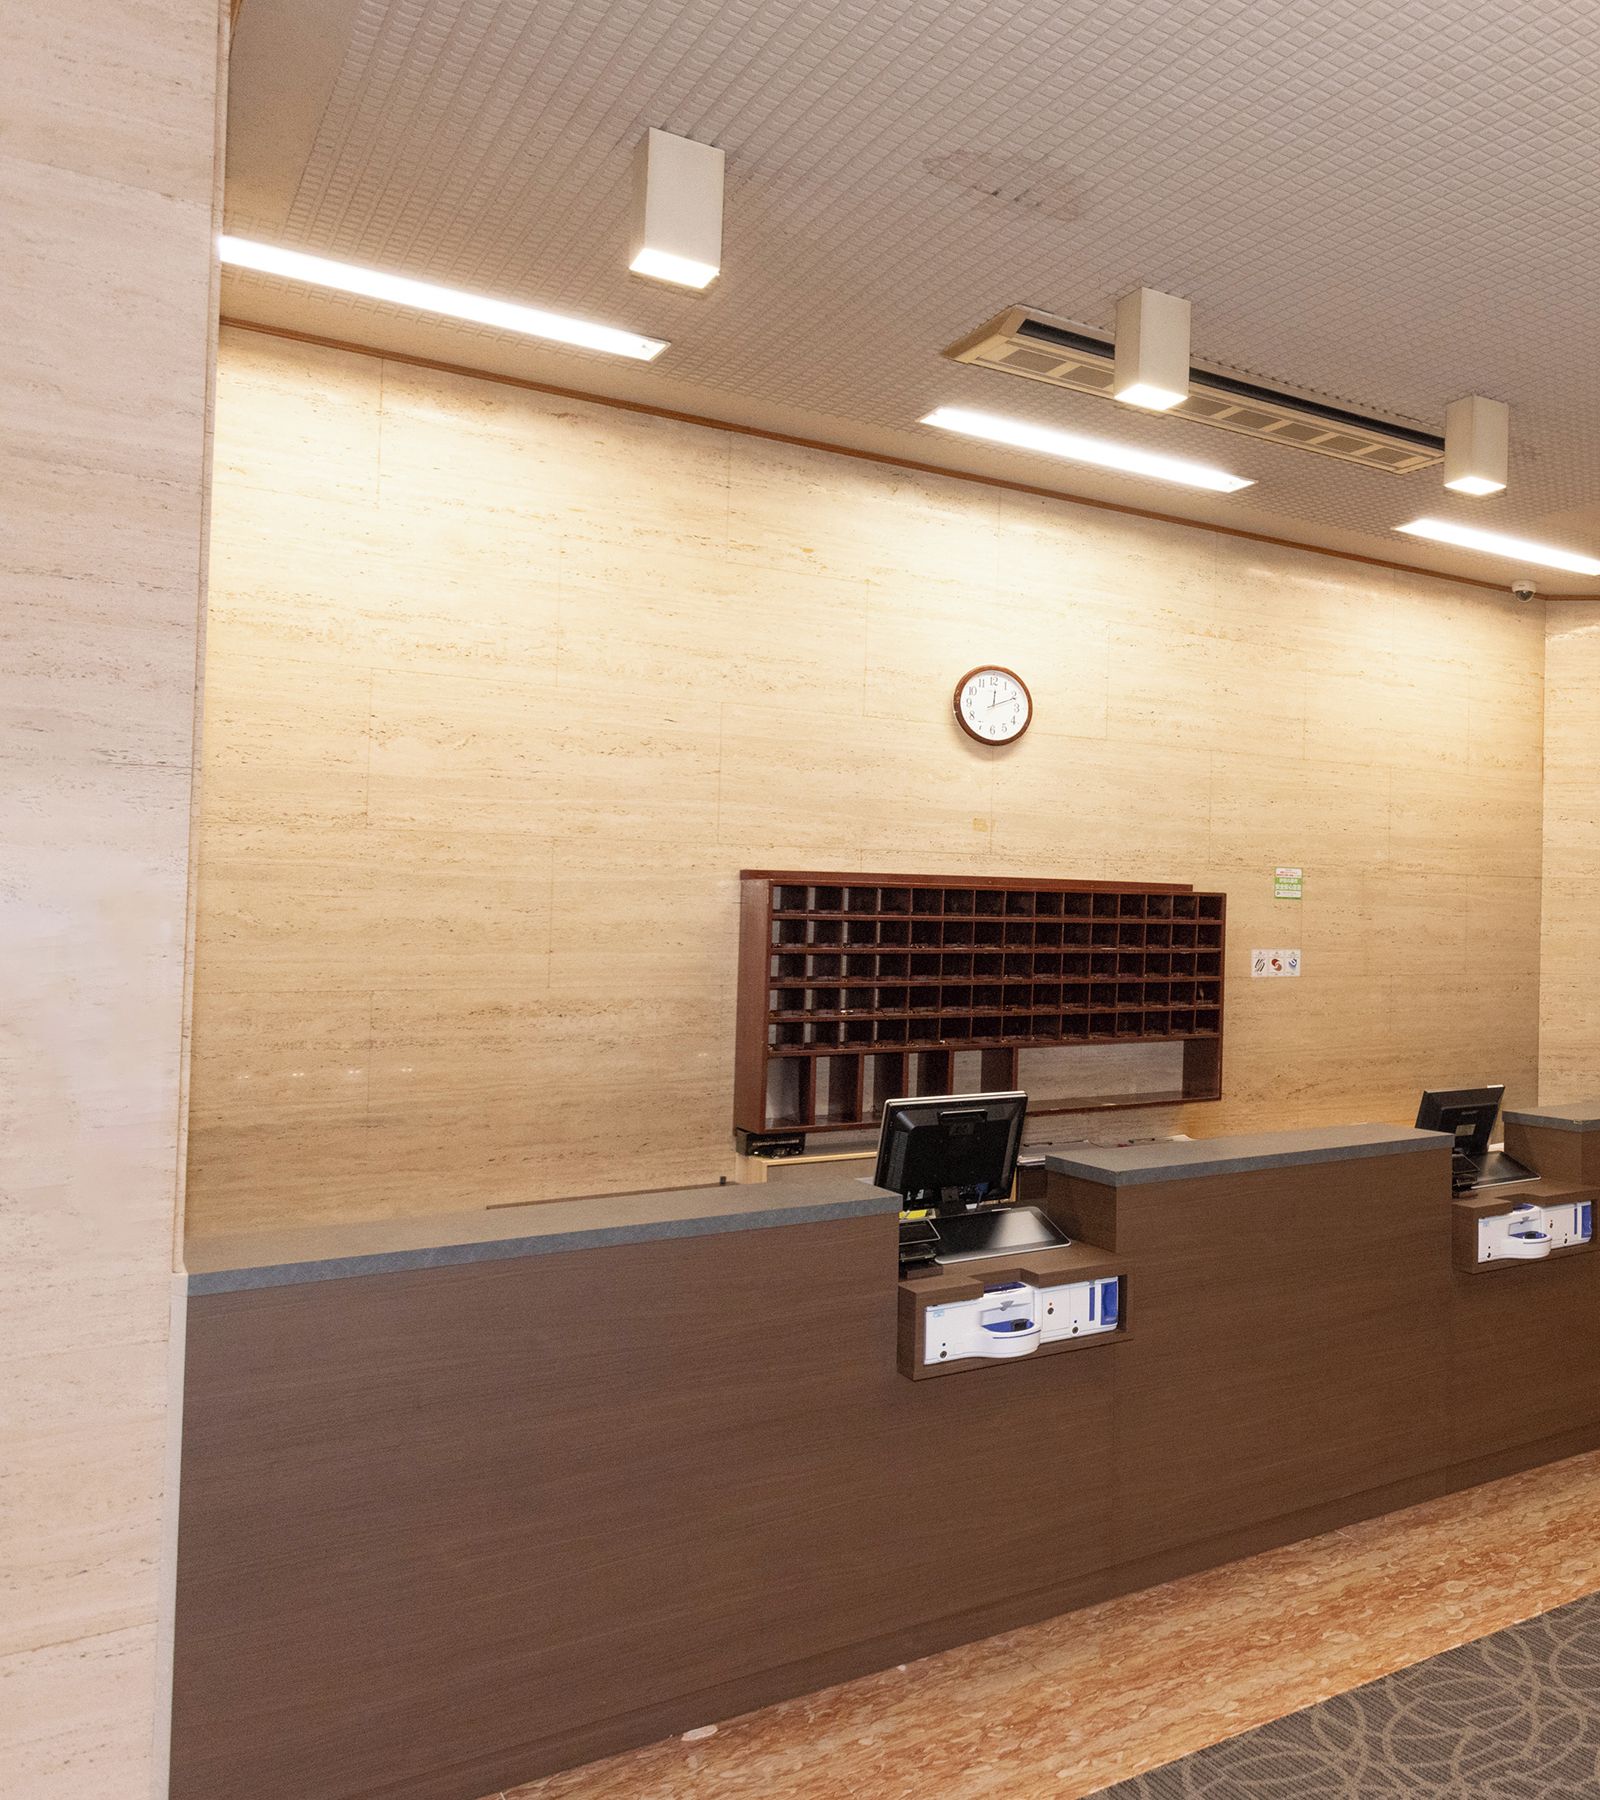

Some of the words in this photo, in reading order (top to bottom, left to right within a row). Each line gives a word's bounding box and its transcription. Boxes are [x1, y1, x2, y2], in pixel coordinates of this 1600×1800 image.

[978, 678, 985, 688] 11
[990, 676, 999, 686] 12
[968, 686, 977, 696] 10
[1011, 691, 1017, 700] 2
[966, 698, 972, 707] 9
[1014, 703, 1020, 713] 3
[969, 710, 975, 720] 8
[1010, 715, 1016, 725] 4
[978, 720, 983, 730] 7
[989, 725, 996, 735] 6
[1001, 723, 1007, 733] 5
